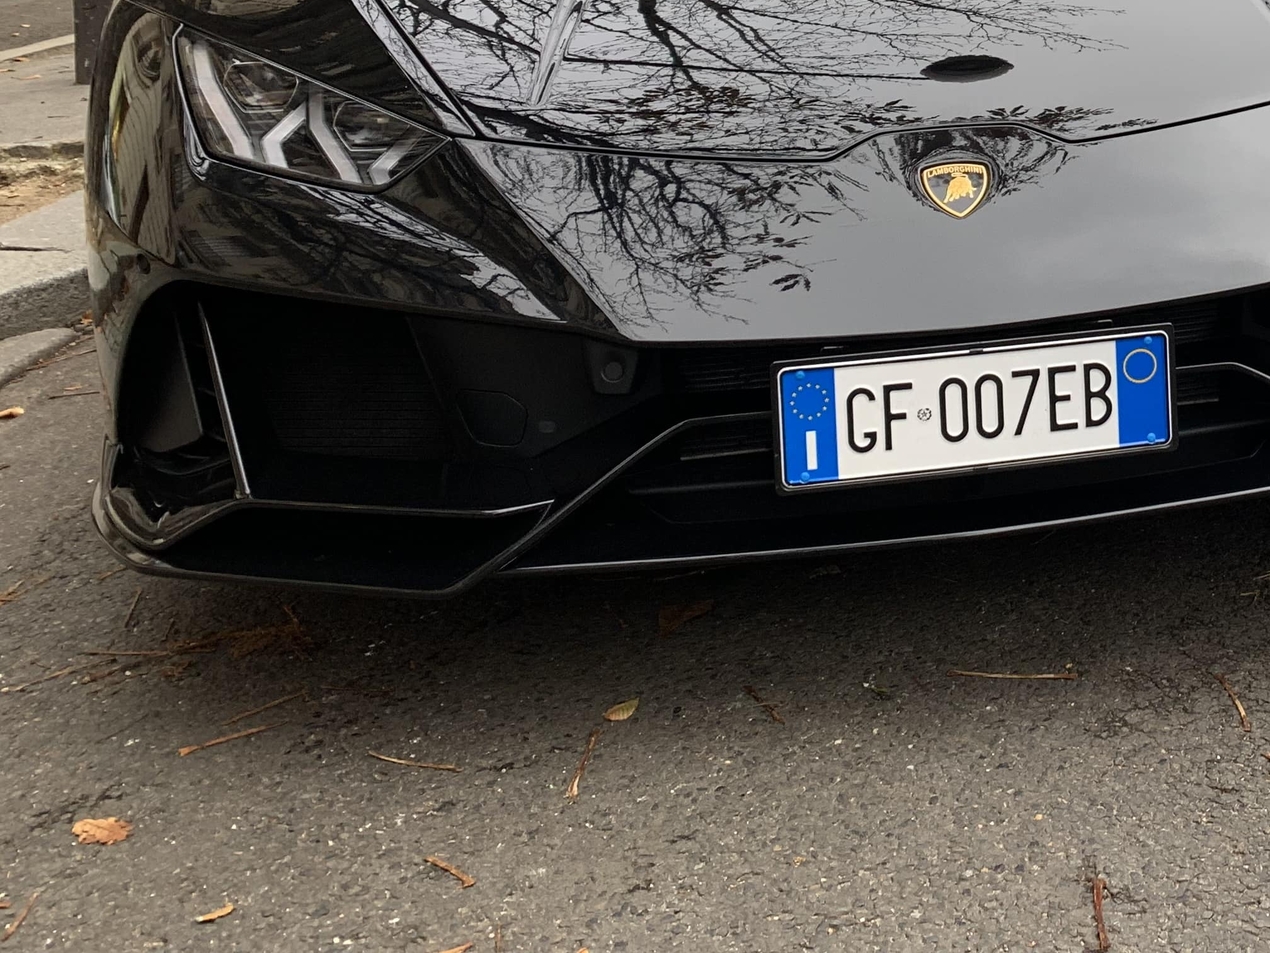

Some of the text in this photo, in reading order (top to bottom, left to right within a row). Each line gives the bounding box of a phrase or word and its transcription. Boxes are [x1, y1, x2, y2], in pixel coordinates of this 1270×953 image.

[927, 165, 984, 179] LAMBORGHINI
[846, 362, 1113, 453] GF 007EB
